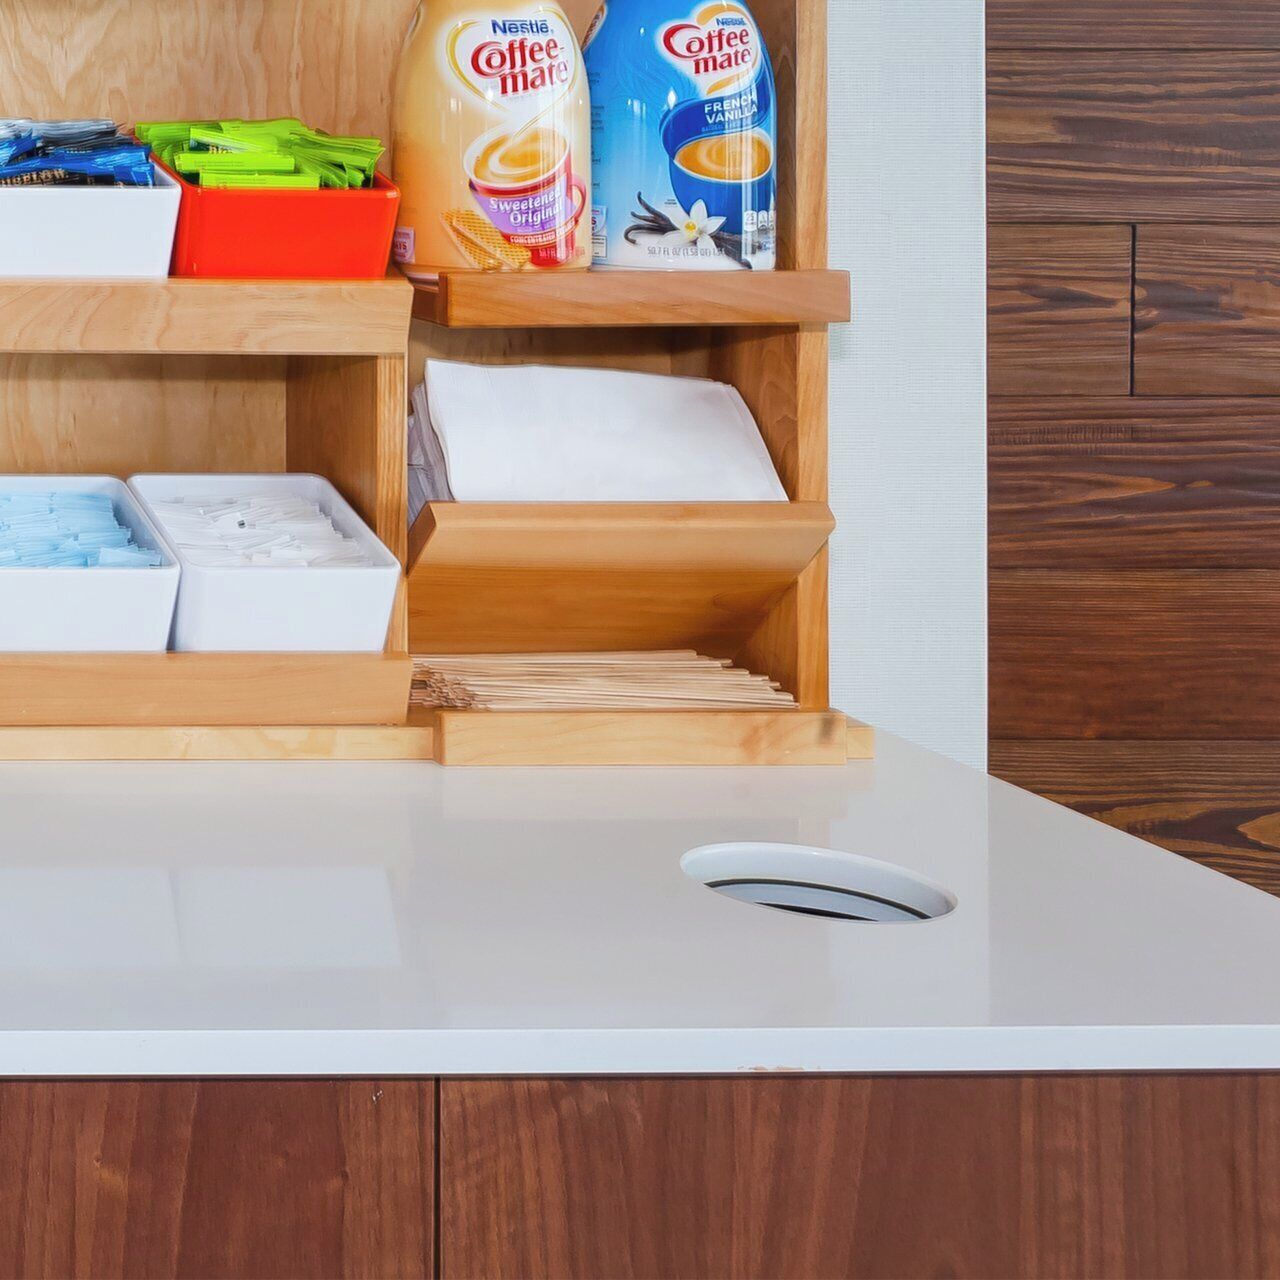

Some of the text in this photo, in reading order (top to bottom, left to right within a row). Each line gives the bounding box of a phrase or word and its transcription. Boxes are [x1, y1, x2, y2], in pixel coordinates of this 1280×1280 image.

[491, 19, 550, 35] Nestlé
[663, 24, 749, 58] Coffee
[693, 48, 751, 75] mate
[499, 60, 567, 95] mate
[704, 88, 757, 113] FRENCH
[705, 104, 758, 124] VANILLA
